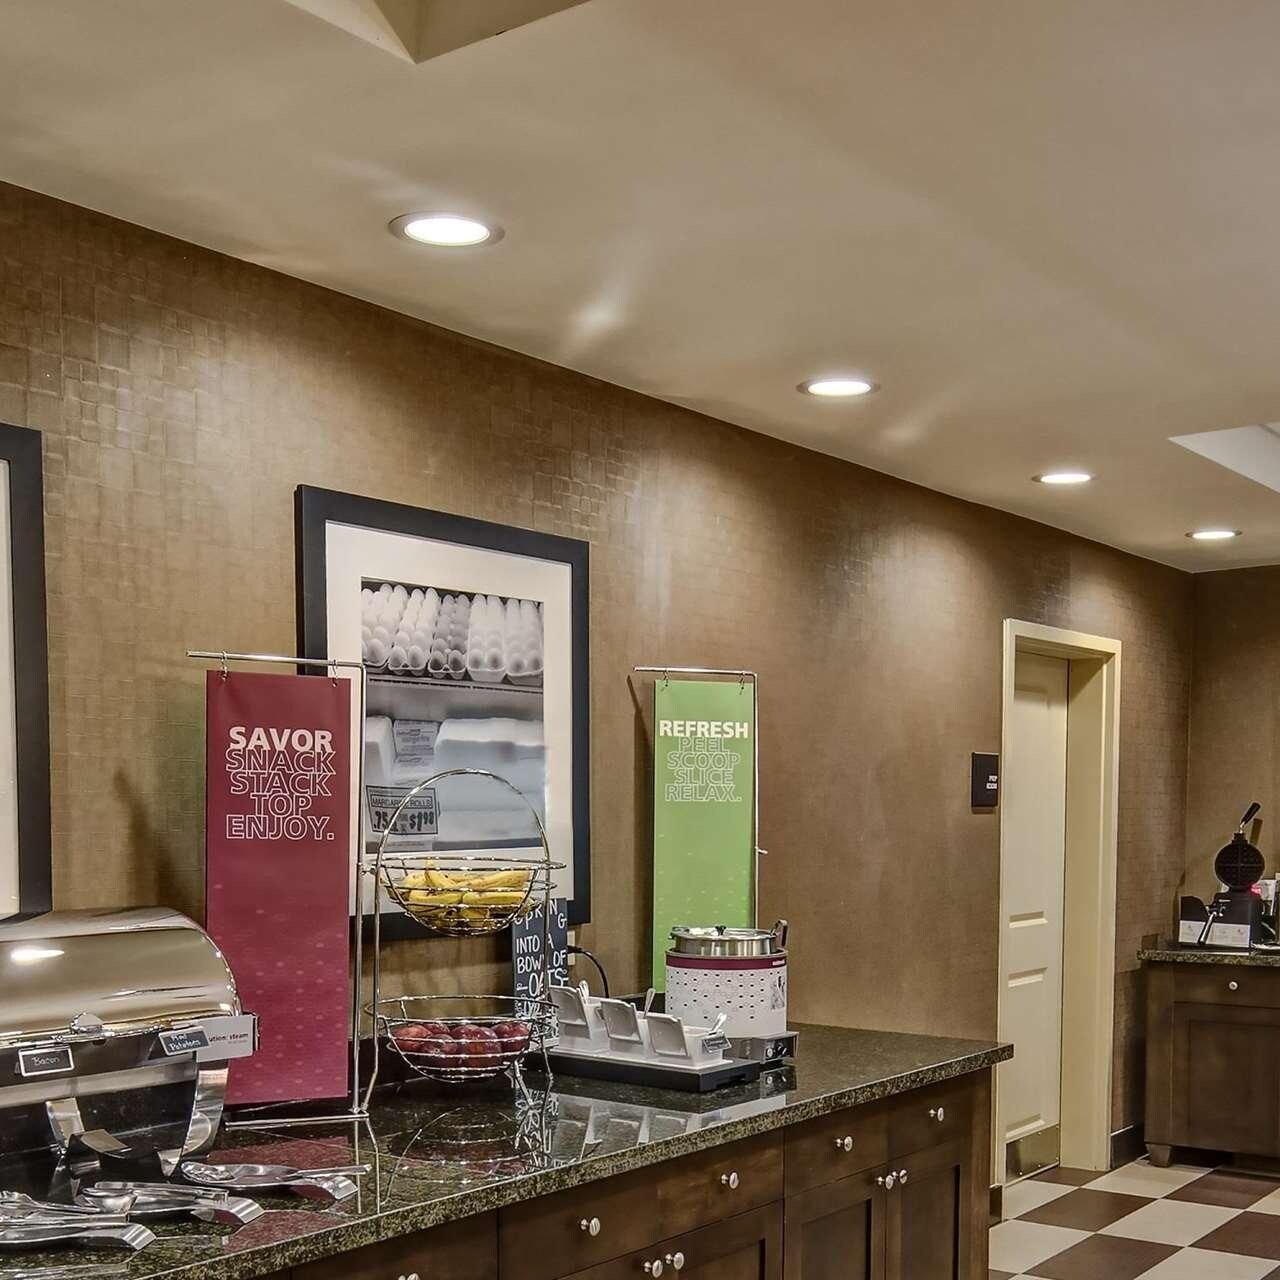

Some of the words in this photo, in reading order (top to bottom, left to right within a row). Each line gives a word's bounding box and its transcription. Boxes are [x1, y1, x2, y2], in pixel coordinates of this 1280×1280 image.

[659, 720, 749, 738] REFRESH
[229, 726, 333, 752] SAVOR
[678, 735, 730, 752] PEEL
[225, 748, 336, 775] SNACK
[666, 751, 741, 770] SCOOP
[230, 770, 332, 796] STACK
[674, 768, 734, 785] SLICE
[665, 783, 743, 802] RELAX.
[250, 793, 312, 817] TOP
[226, 814, 335, 840] ENJOY.
[516, 935, 540, 954] INTO
[517, 954, 550, 974] BOW
[553, 950, 567, 967] OF
[31, 1056, 60, 1066] Bacon
